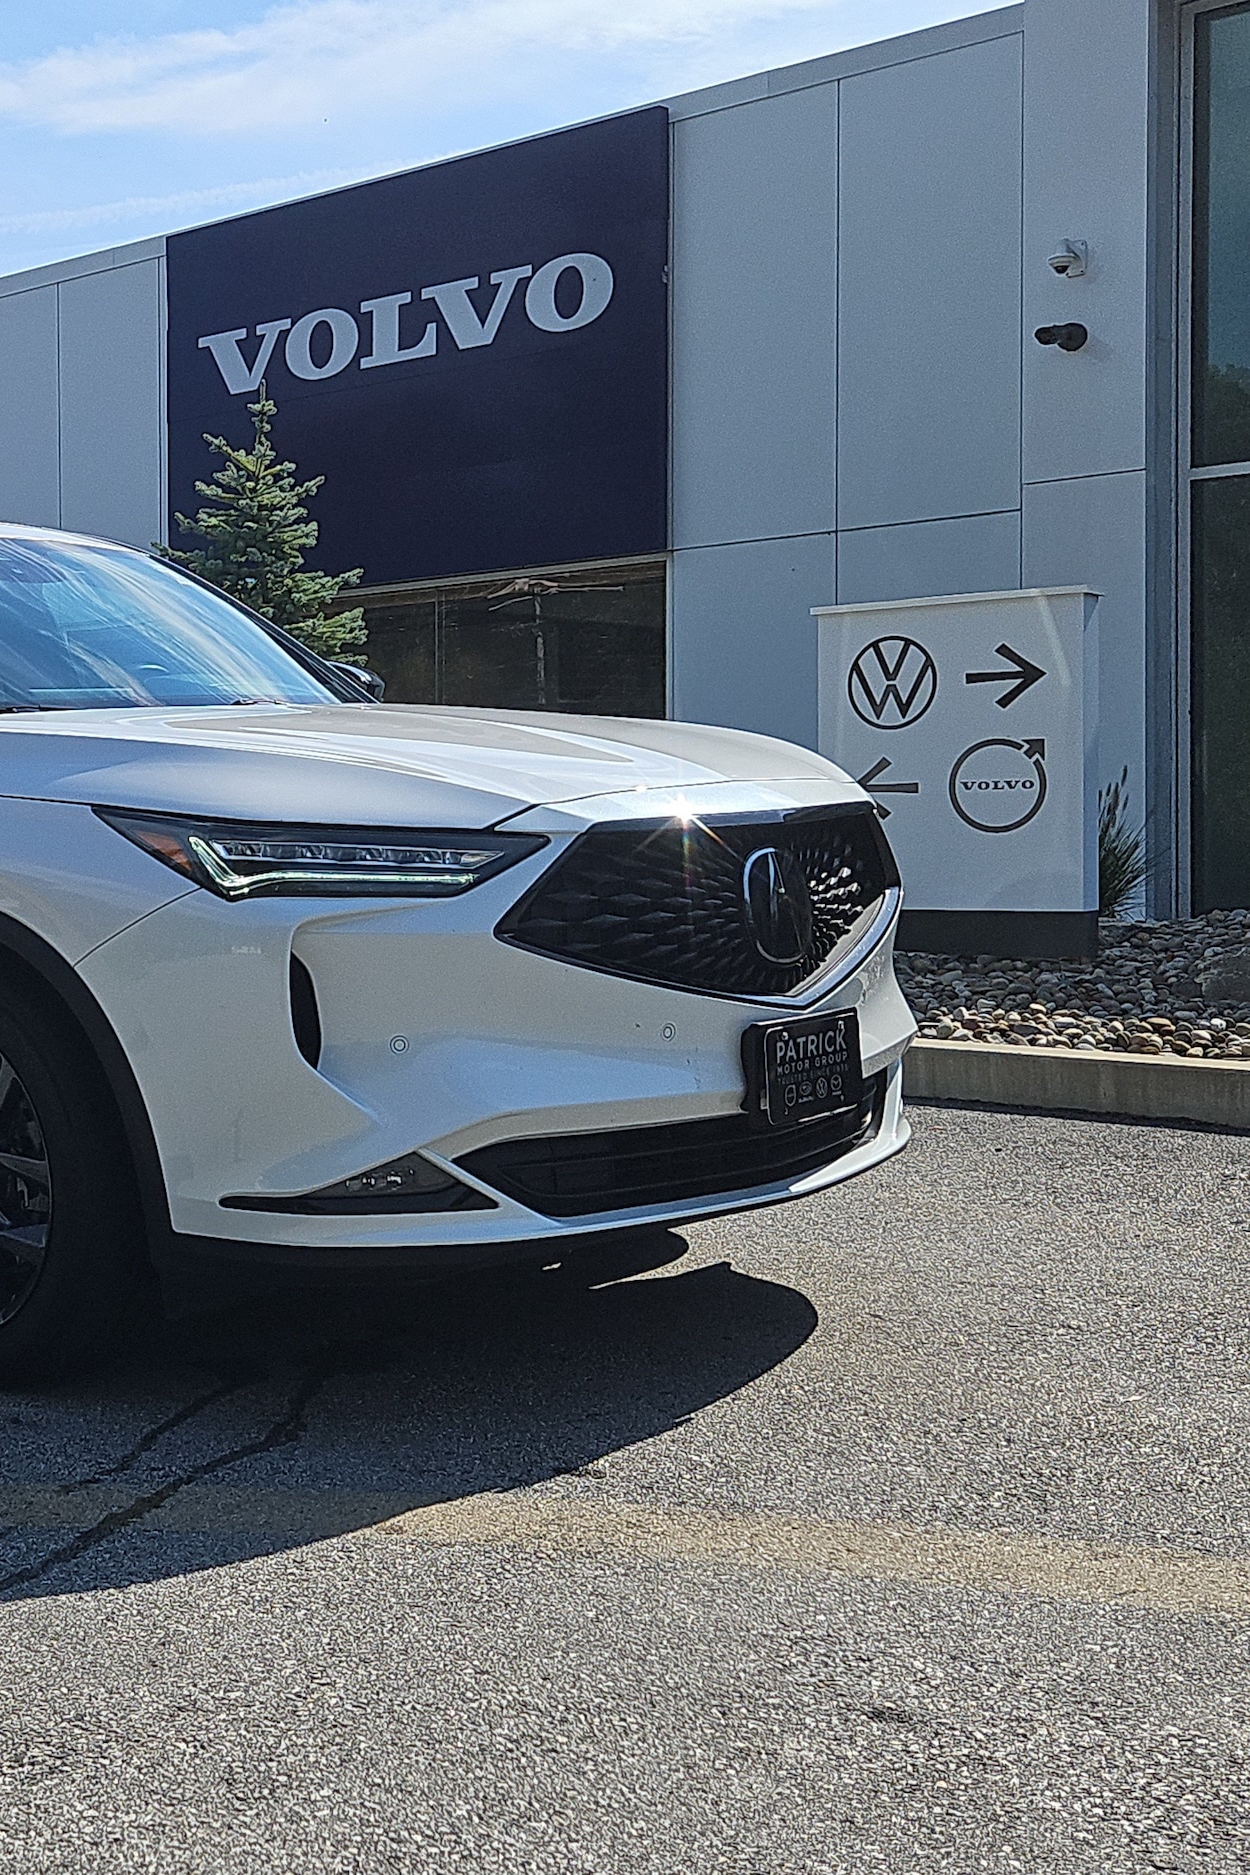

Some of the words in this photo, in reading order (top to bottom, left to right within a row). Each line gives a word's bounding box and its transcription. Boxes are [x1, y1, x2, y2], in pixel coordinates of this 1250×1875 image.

[197, 252, 615, 395] VOLVO
[960, 778, 1035, 791] VOLVO
[776, 1028, 847, 1064] PATRICK
[777, 1059, 810, 1076] MOTOR
[814, 1051, 848, 1067] GROUP
